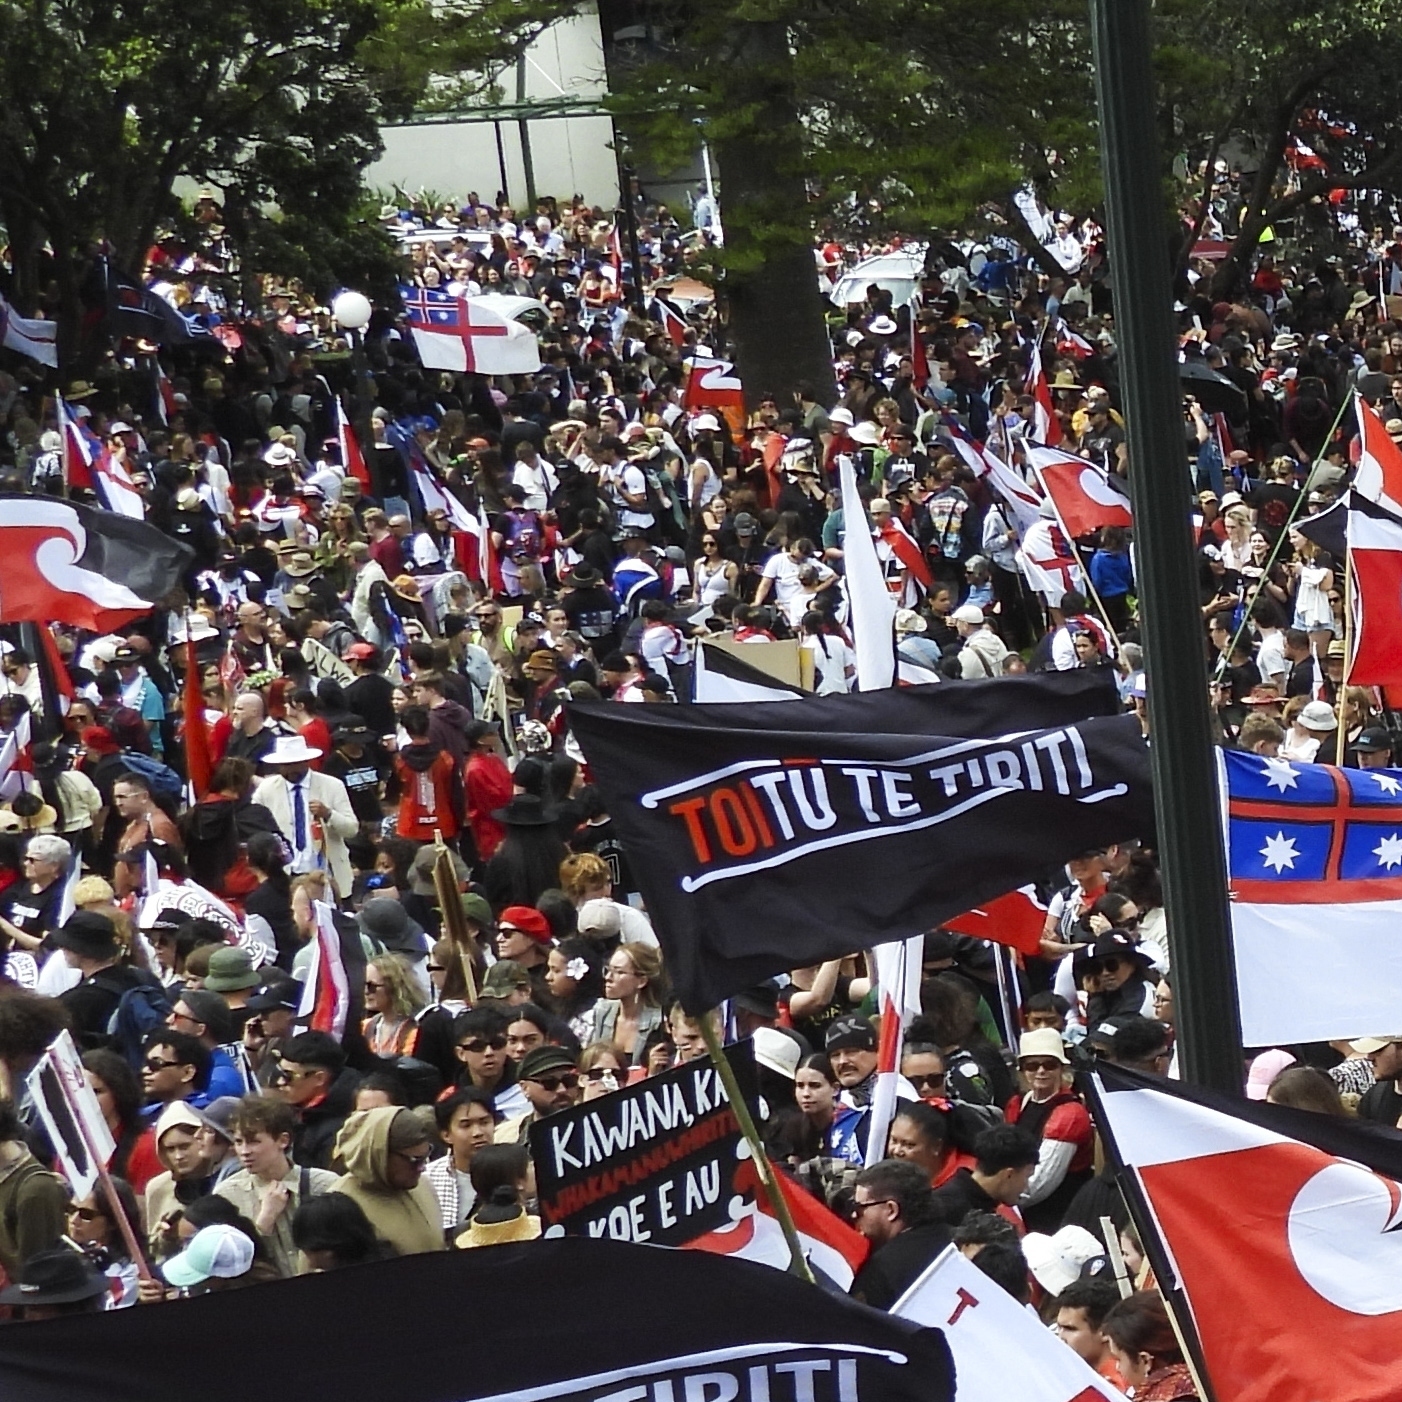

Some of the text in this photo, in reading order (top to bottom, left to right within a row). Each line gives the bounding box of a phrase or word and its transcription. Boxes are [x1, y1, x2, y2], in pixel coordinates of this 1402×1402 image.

[843, 767, 921, 823] TE
[551, 1082, 695, 1178] KAWANA,
[658, 1180, 677, 1229] E
[685, 1159, 721, 1216] AU
